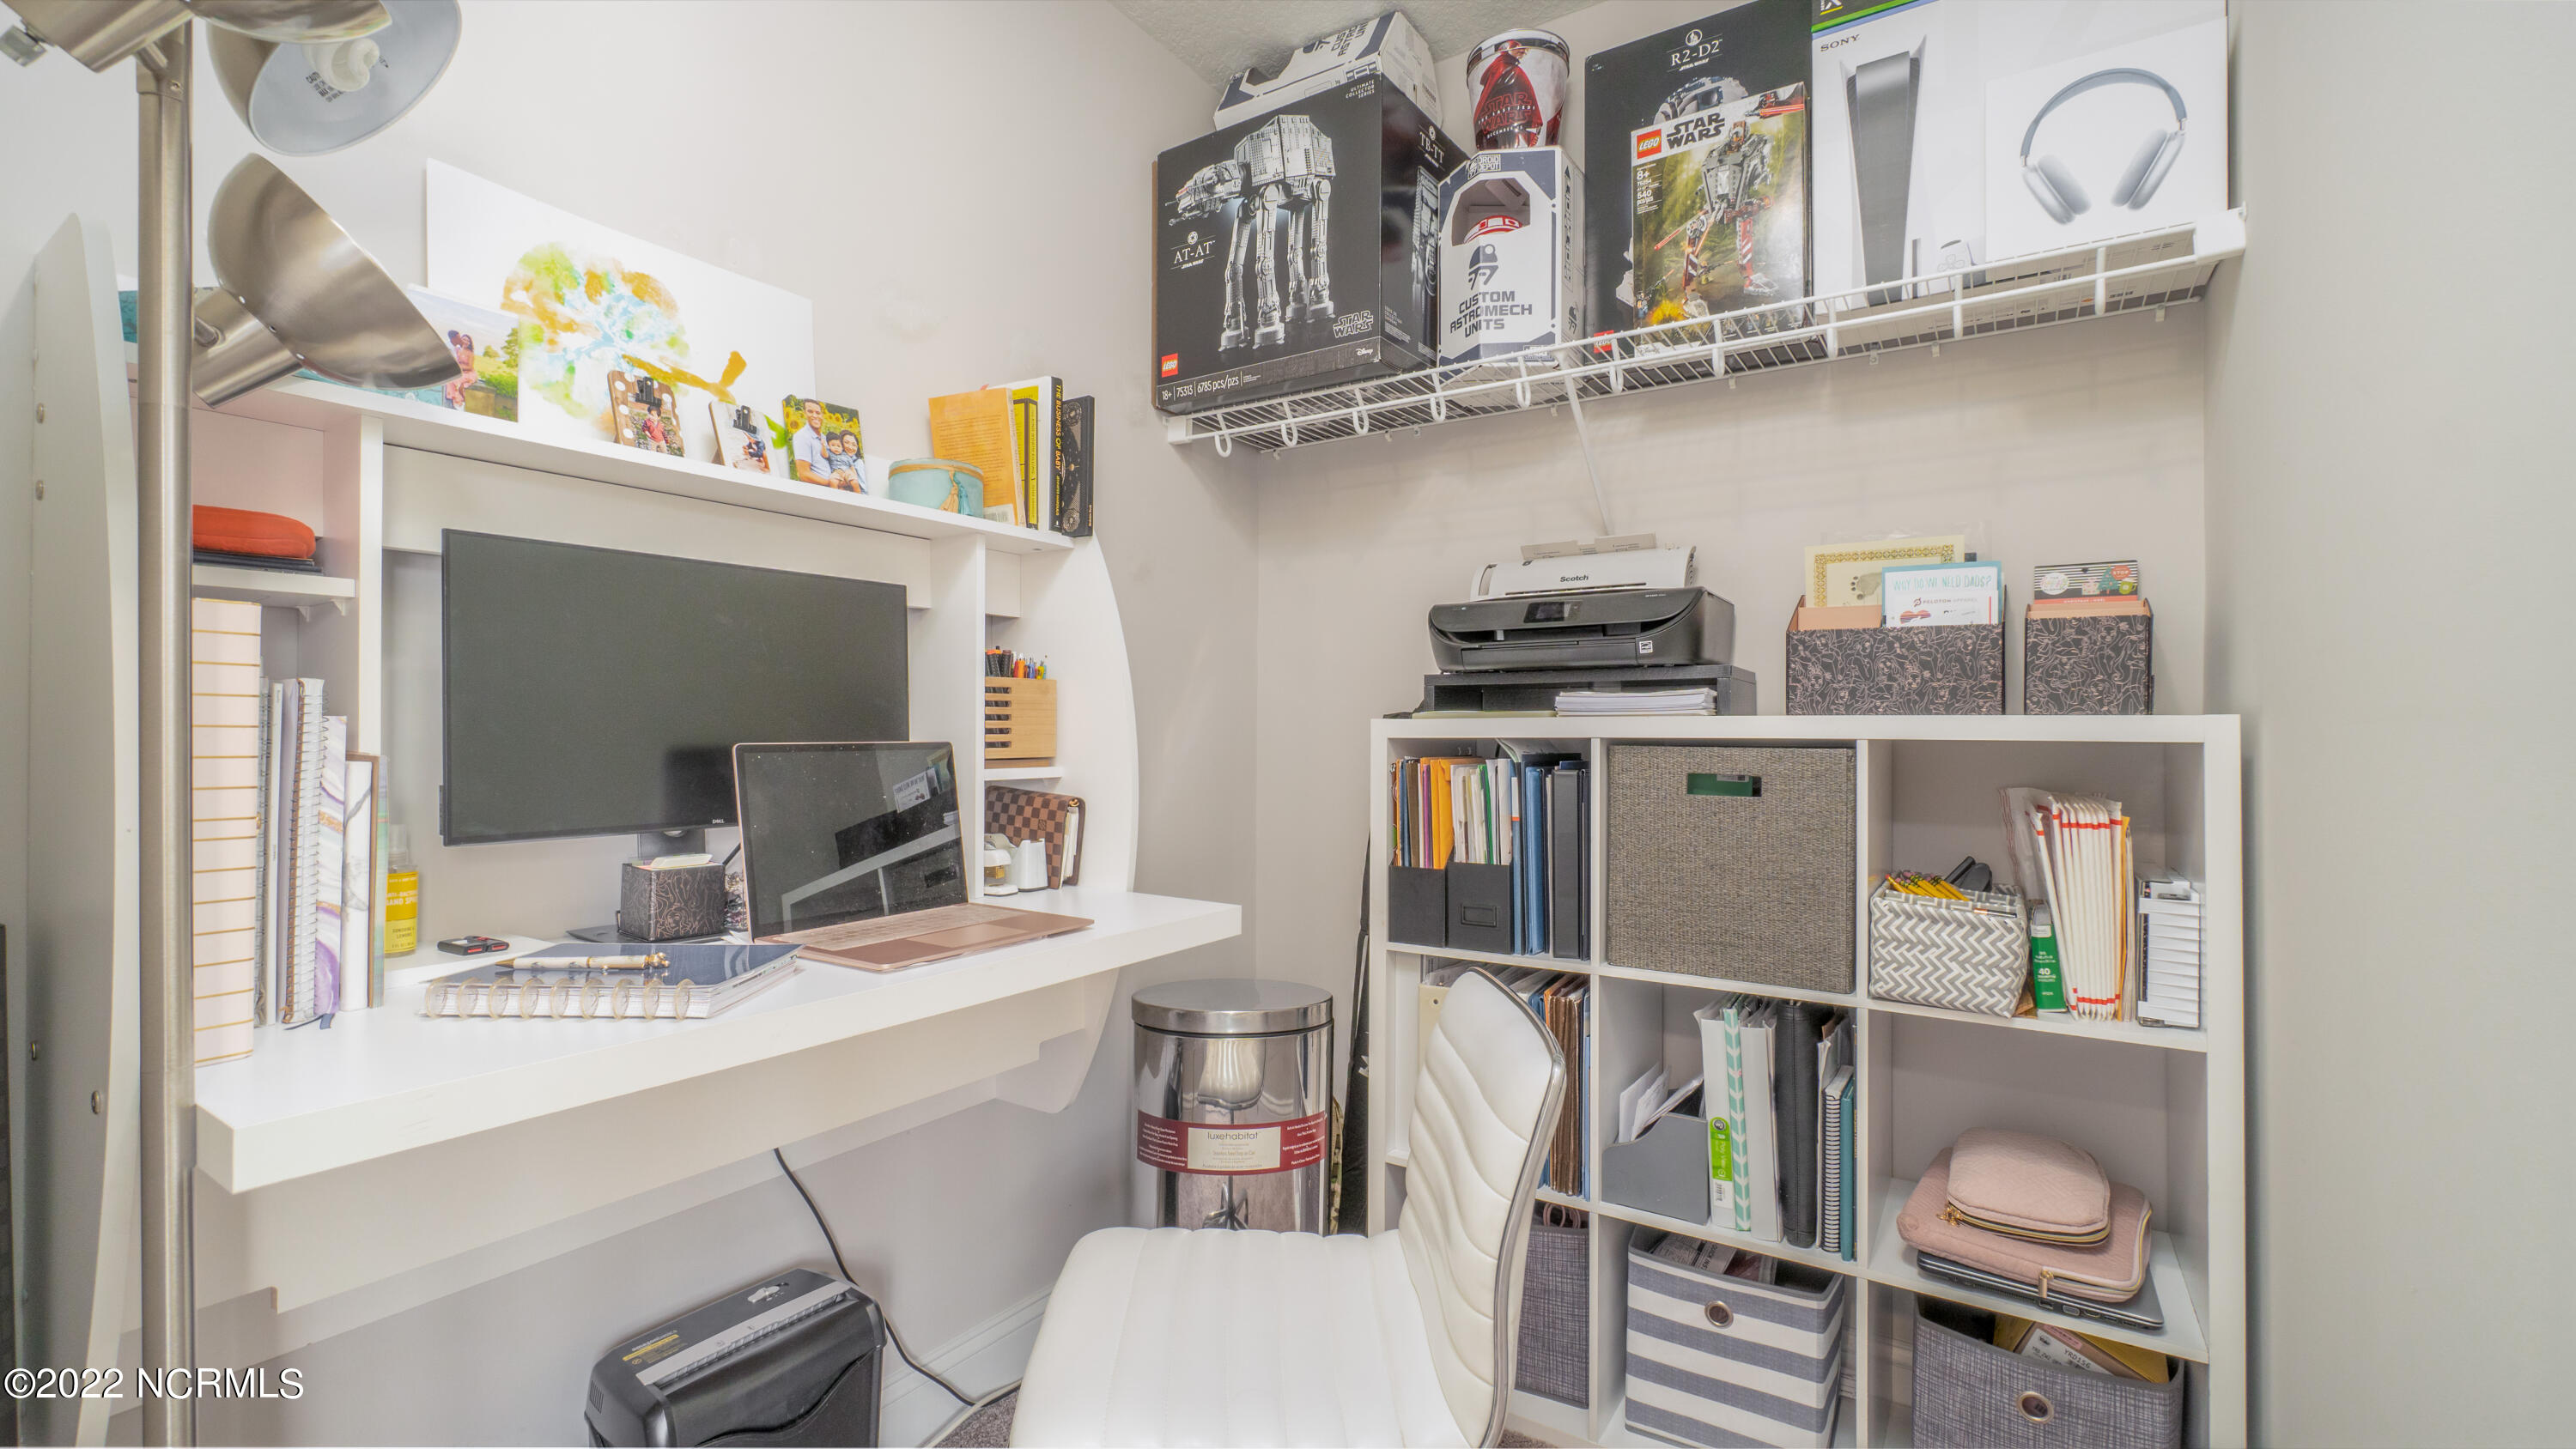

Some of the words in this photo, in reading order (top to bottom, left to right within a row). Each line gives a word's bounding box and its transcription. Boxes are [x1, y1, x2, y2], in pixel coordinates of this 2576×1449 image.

[1820, 34, 1860, 52] SONY
[1666, 112, 1726, 137] STAR
[1638, 136, 1661, 152] LEGO
[1667, 123, 1725, 149] WARS
[1459, 290, 1516, 314] CUSTOM
[1334, 310, 1374, 328] STAR
[1449, 304, 1533, 334] ASTROMECH
[1465, 318, 1505, 338] UNITS
[1334, 320, 1374, 338] WARS
[1356, 348, 1374, 356] Disney
[1163, 361, 1177, 372] LEGO
[1161, 390, 1172, 401] 18+
[1176, 385, 1194, 398] 75313
[1197, 380, 1212, 393] 6785
[1212, 374, 1239, 391] pcs/pzs
[1054, 436, 1062, 450] OF
[1560, 574, 1589, 583] Scotch
[1894, 579, 1911, 591] WHY
[1941, 575, 1962, 588] NEED
[1964, 574, 1992, 588] DADS?
[1207, 1131, 1258, 1141] luxehabitat
